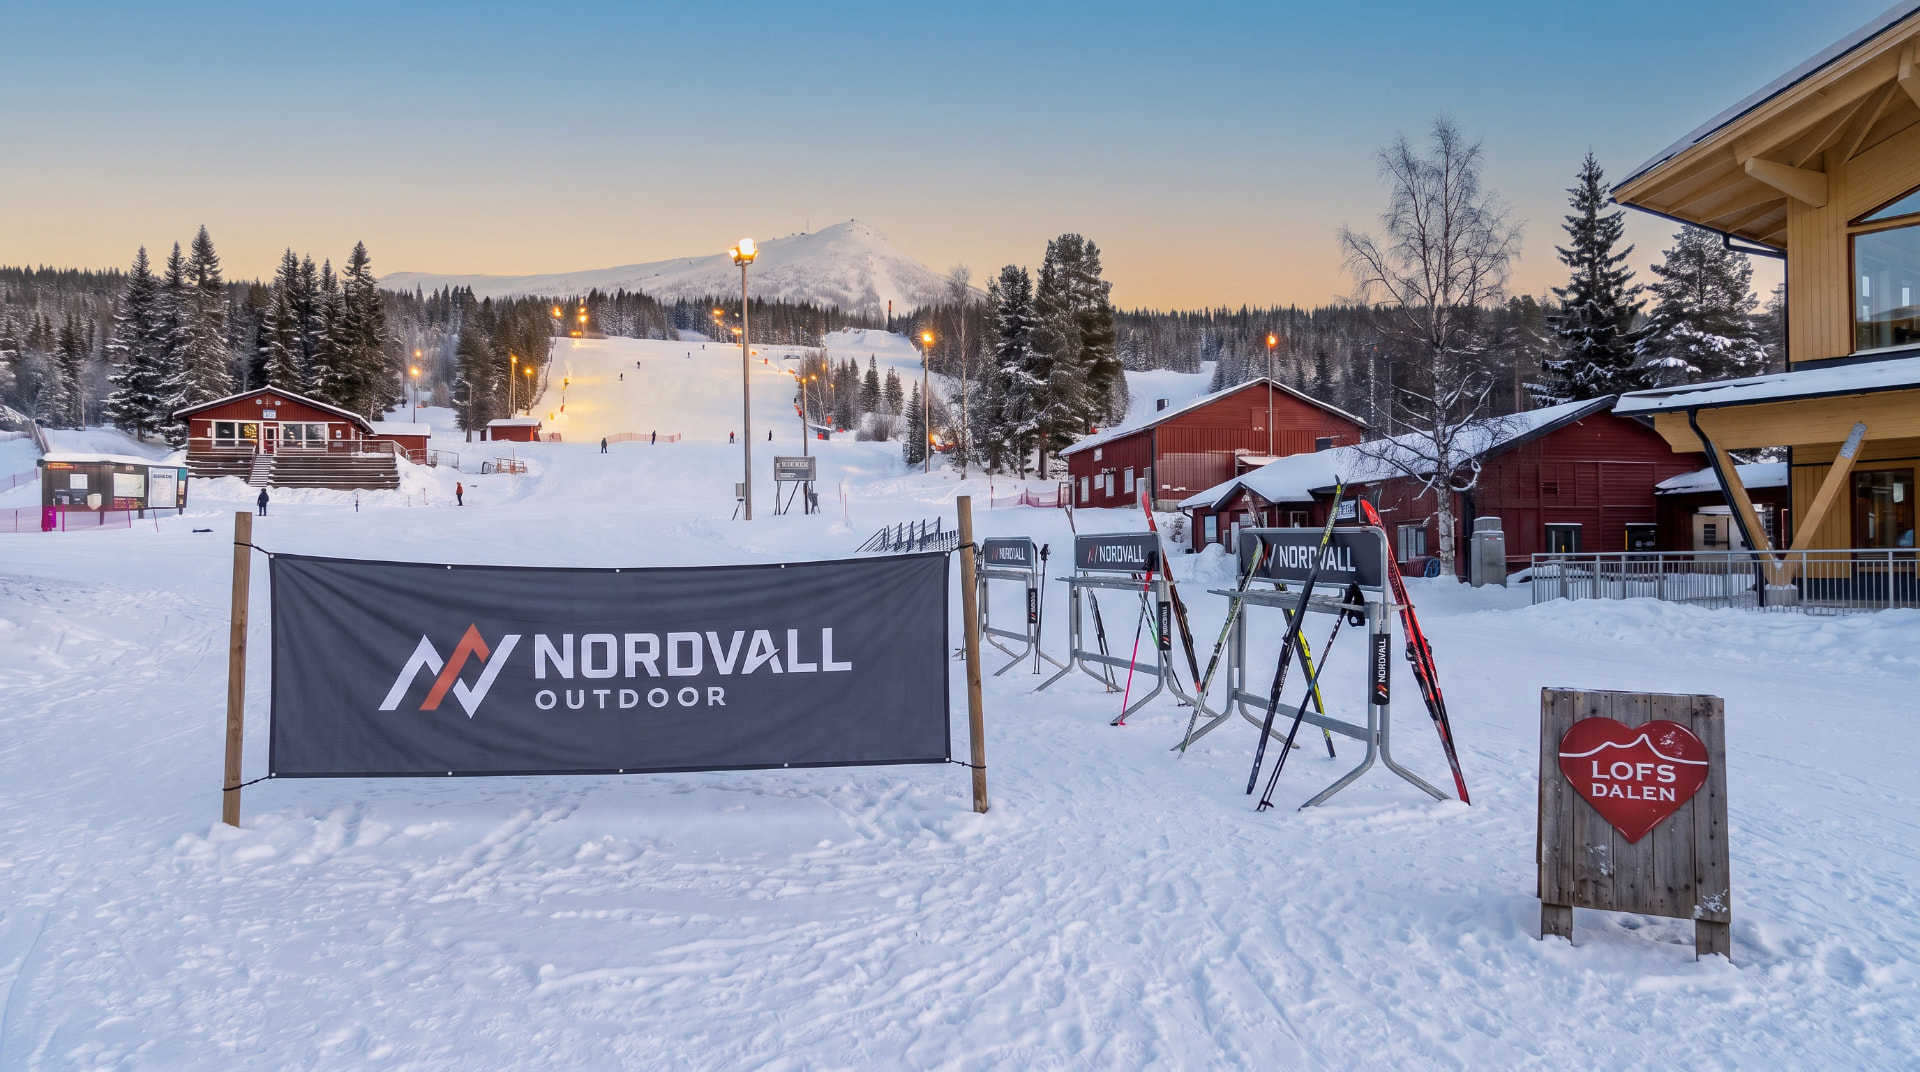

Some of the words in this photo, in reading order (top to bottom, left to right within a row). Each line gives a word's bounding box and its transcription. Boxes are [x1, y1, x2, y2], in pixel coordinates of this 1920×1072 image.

[1099, 544, 1145, 563] NORDVALL
[534, 627, 853, 680] NORDVALL
[1378, 638, 1386, 683] NORDVALL
[534, 686, 727, 711] OUTDOOR
[1591, 760, 1676, 783] LOFS
[1591, 783, 1676, 802] DALEN
